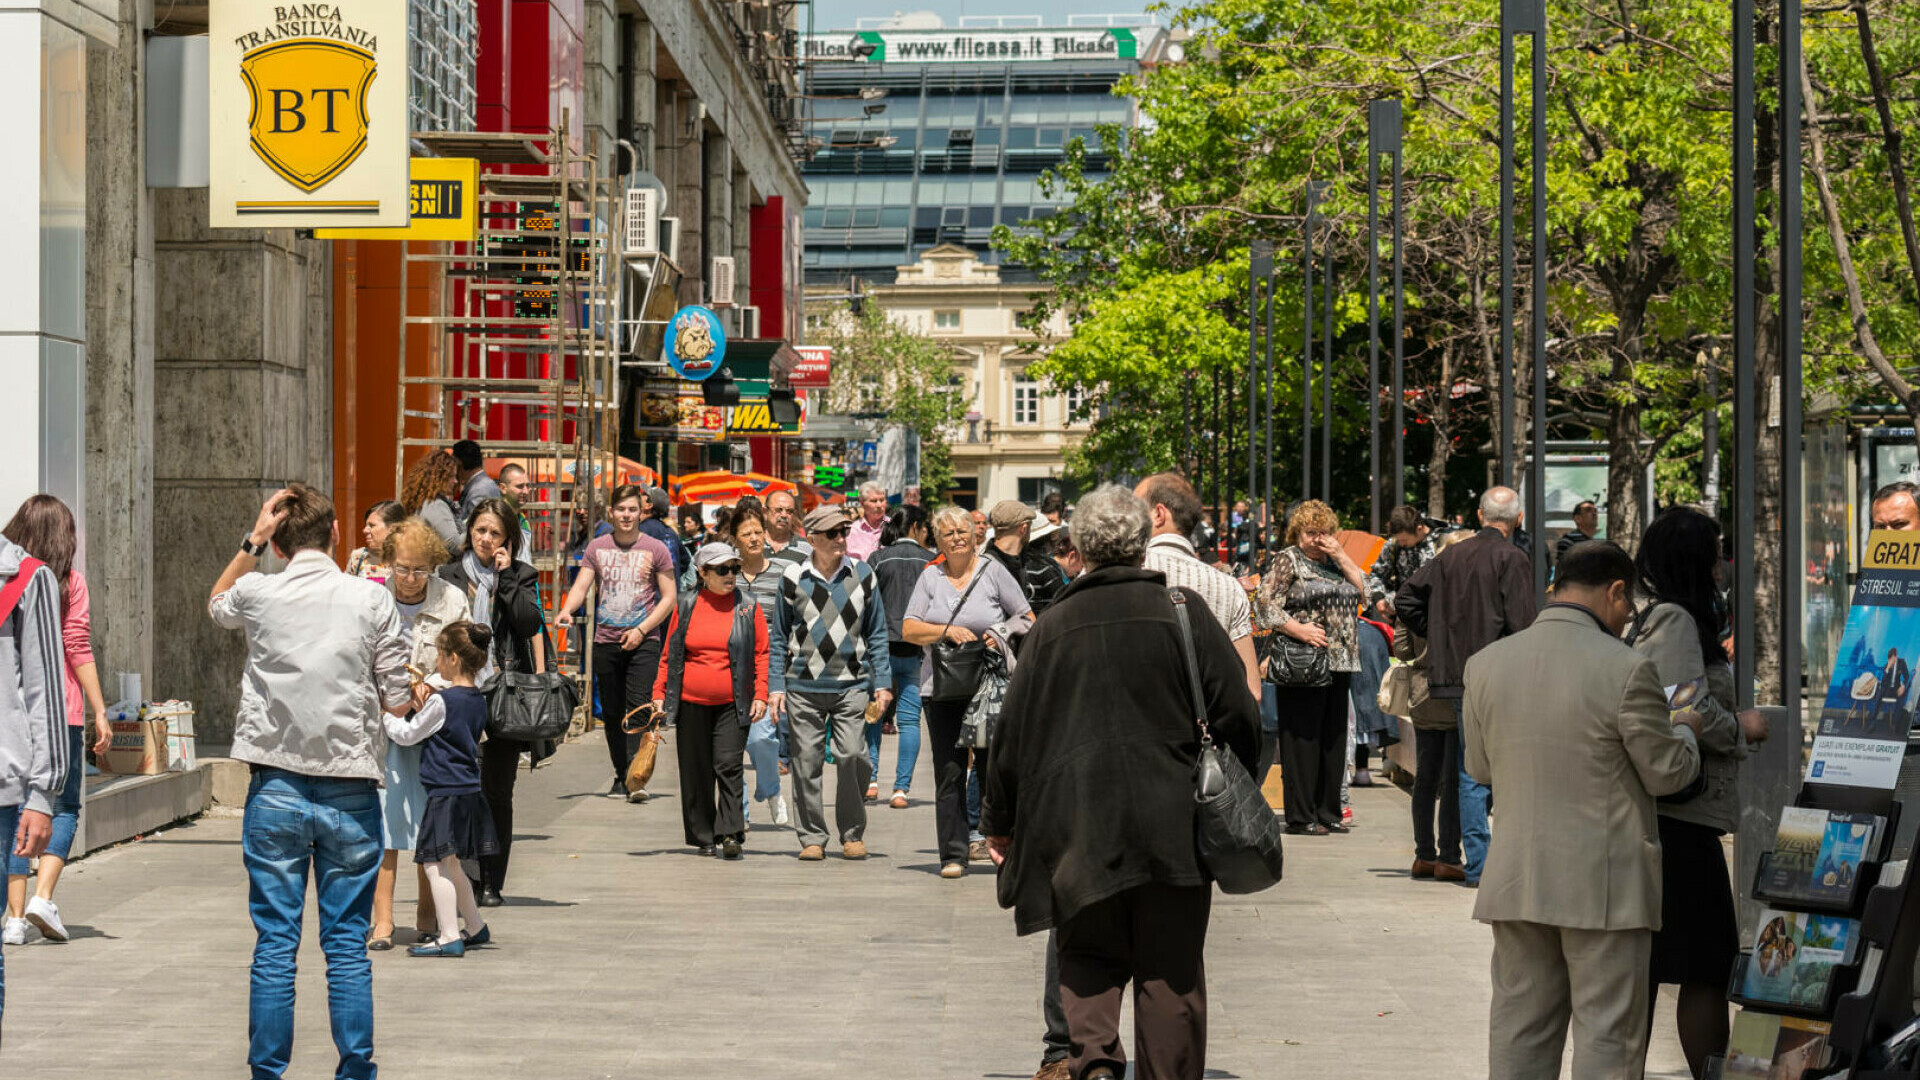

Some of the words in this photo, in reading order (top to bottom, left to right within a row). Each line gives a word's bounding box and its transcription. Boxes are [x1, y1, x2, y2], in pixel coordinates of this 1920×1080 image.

[274, 4, 342, 22] BANCA
[235, 21, 378, 52] TRANSILVANIA
[267, 89, 350, 133] BT
[601, 566, 641, 582] COME
[1860, 579, 1903, 595] STRESUL
